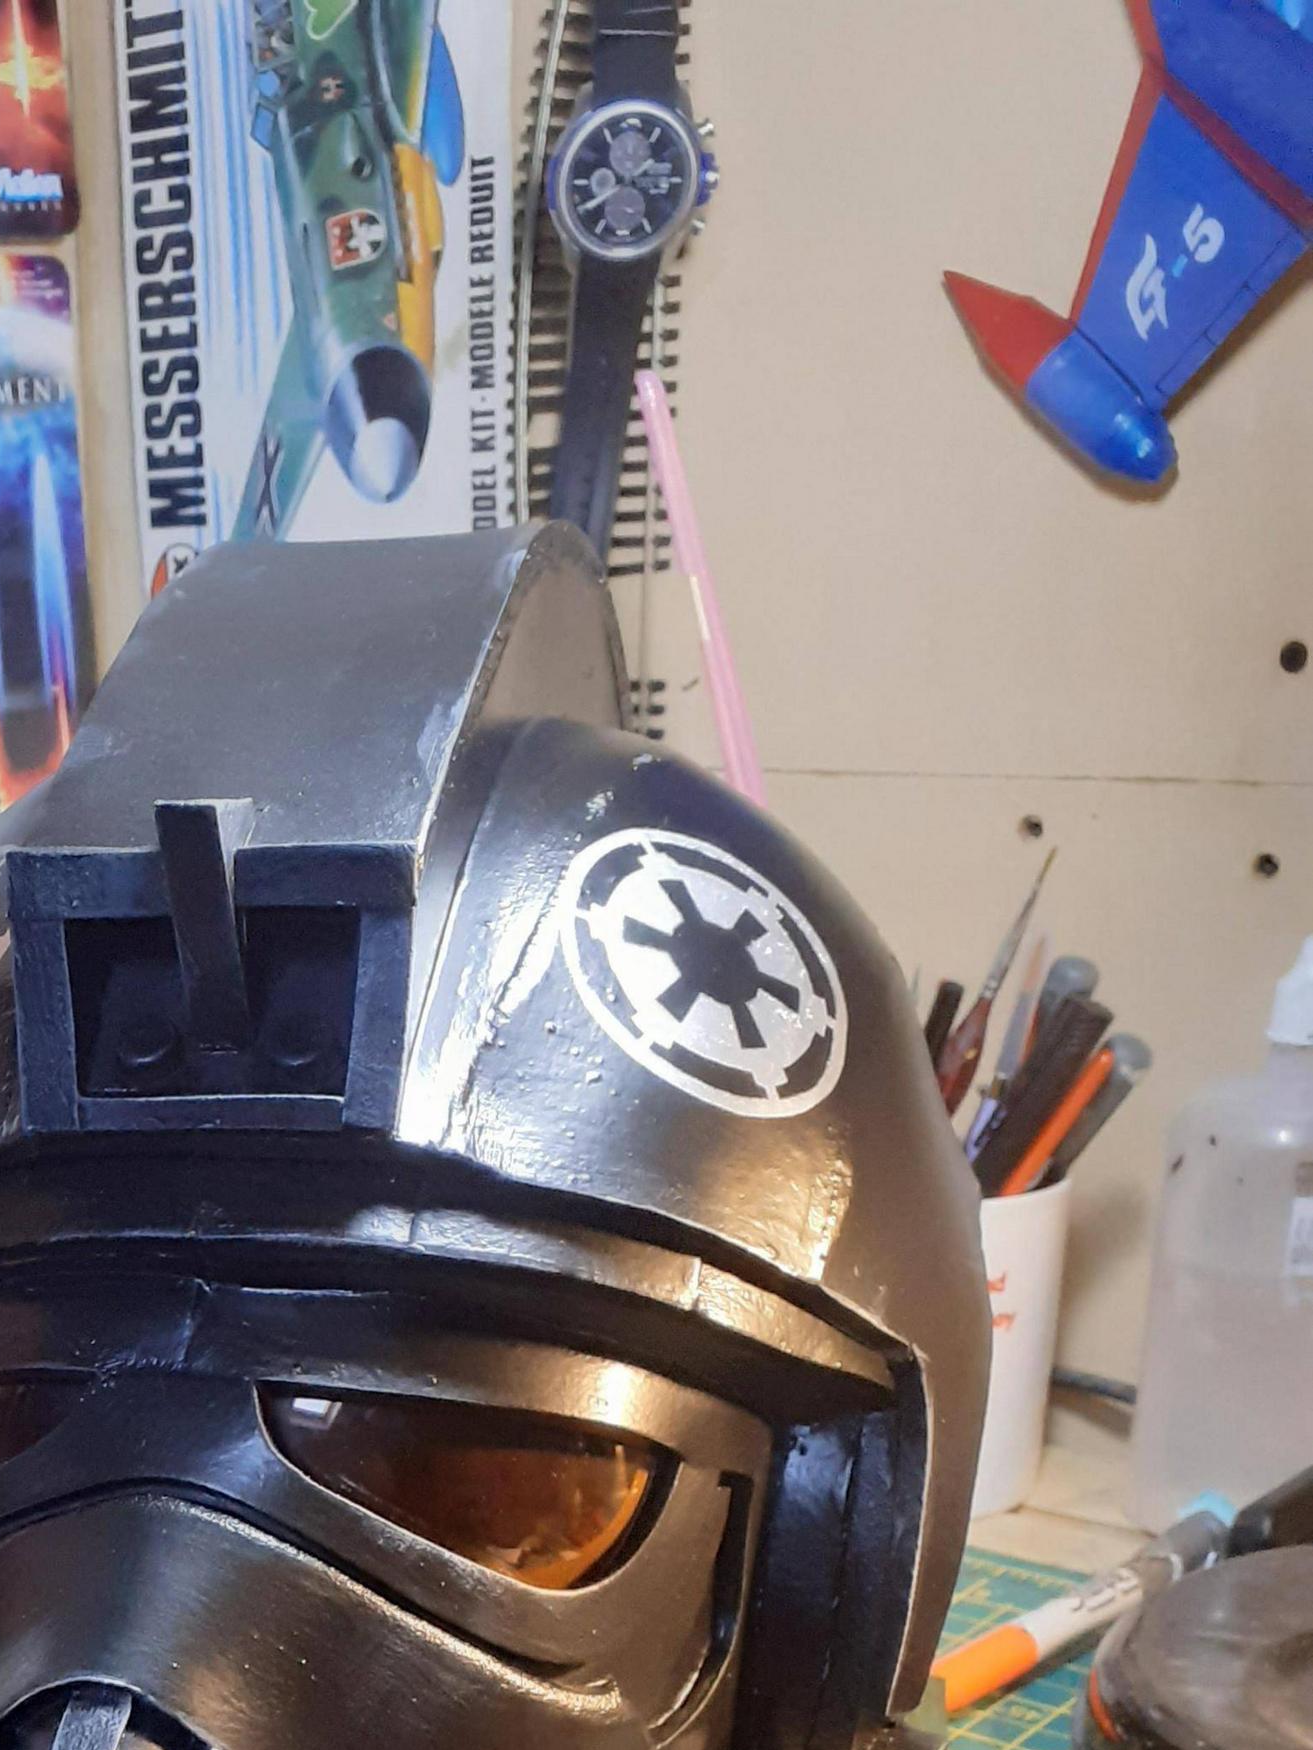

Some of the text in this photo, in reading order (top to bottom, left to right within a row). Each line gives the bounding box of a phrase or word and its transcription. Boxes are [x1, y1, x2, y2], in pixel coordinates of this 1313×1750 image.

[124, 0, 209, 528] MESSERSCHMIT
[468, 153, 499, 532] ODEL KIT MODELE REDUIT
